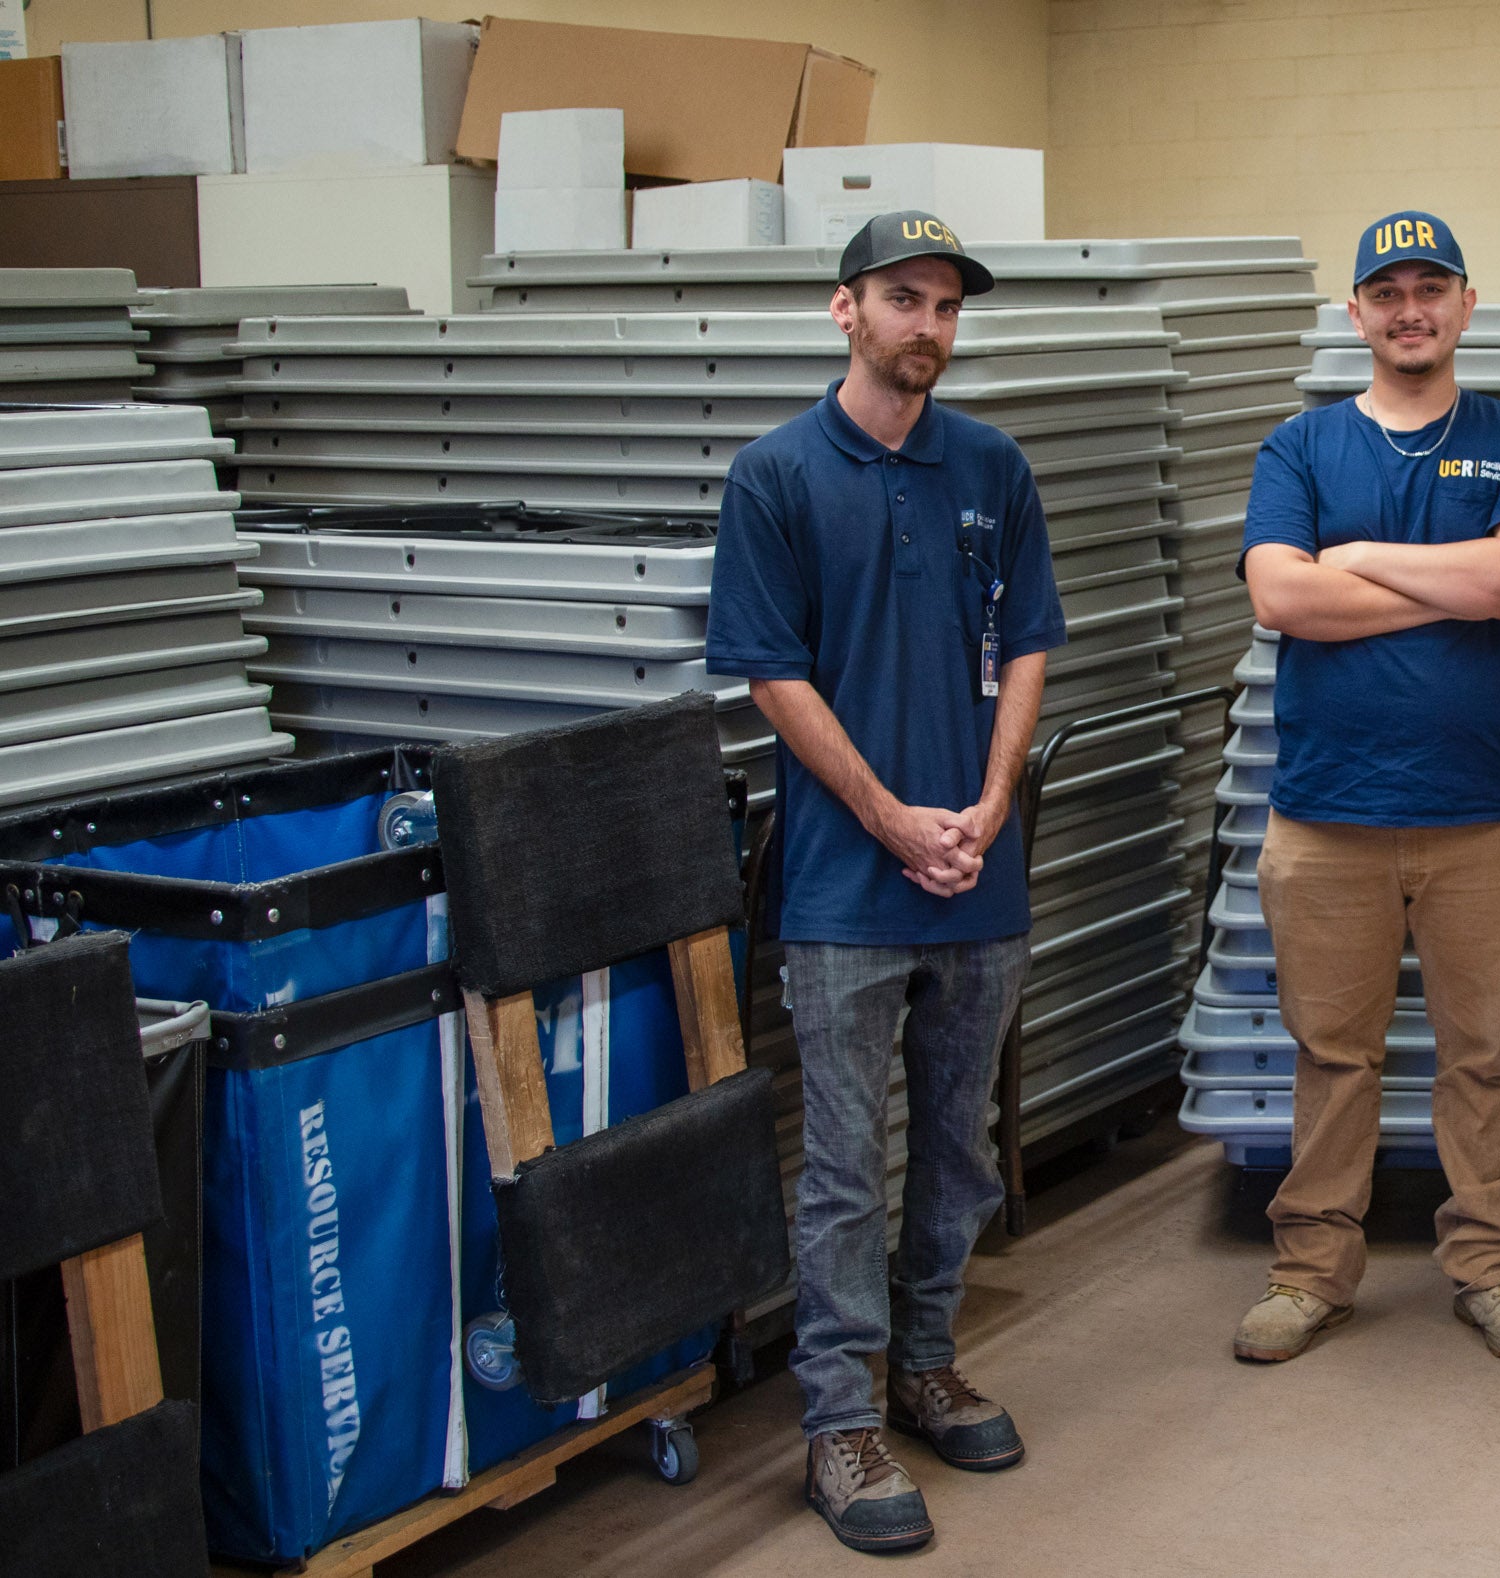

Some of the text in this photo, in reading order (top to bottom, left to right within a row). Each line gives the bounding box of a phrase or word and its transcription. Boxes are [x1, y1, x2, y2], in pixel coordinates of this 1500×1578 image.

[902, 219, 959, 252] UCR
[1375, 219, 1438, 255] UCR
[1438, 459, 1474, 479] UCR
[961, 511, 975, 522] UCR
[300, 1098, 347, 1323] RESOURCE
